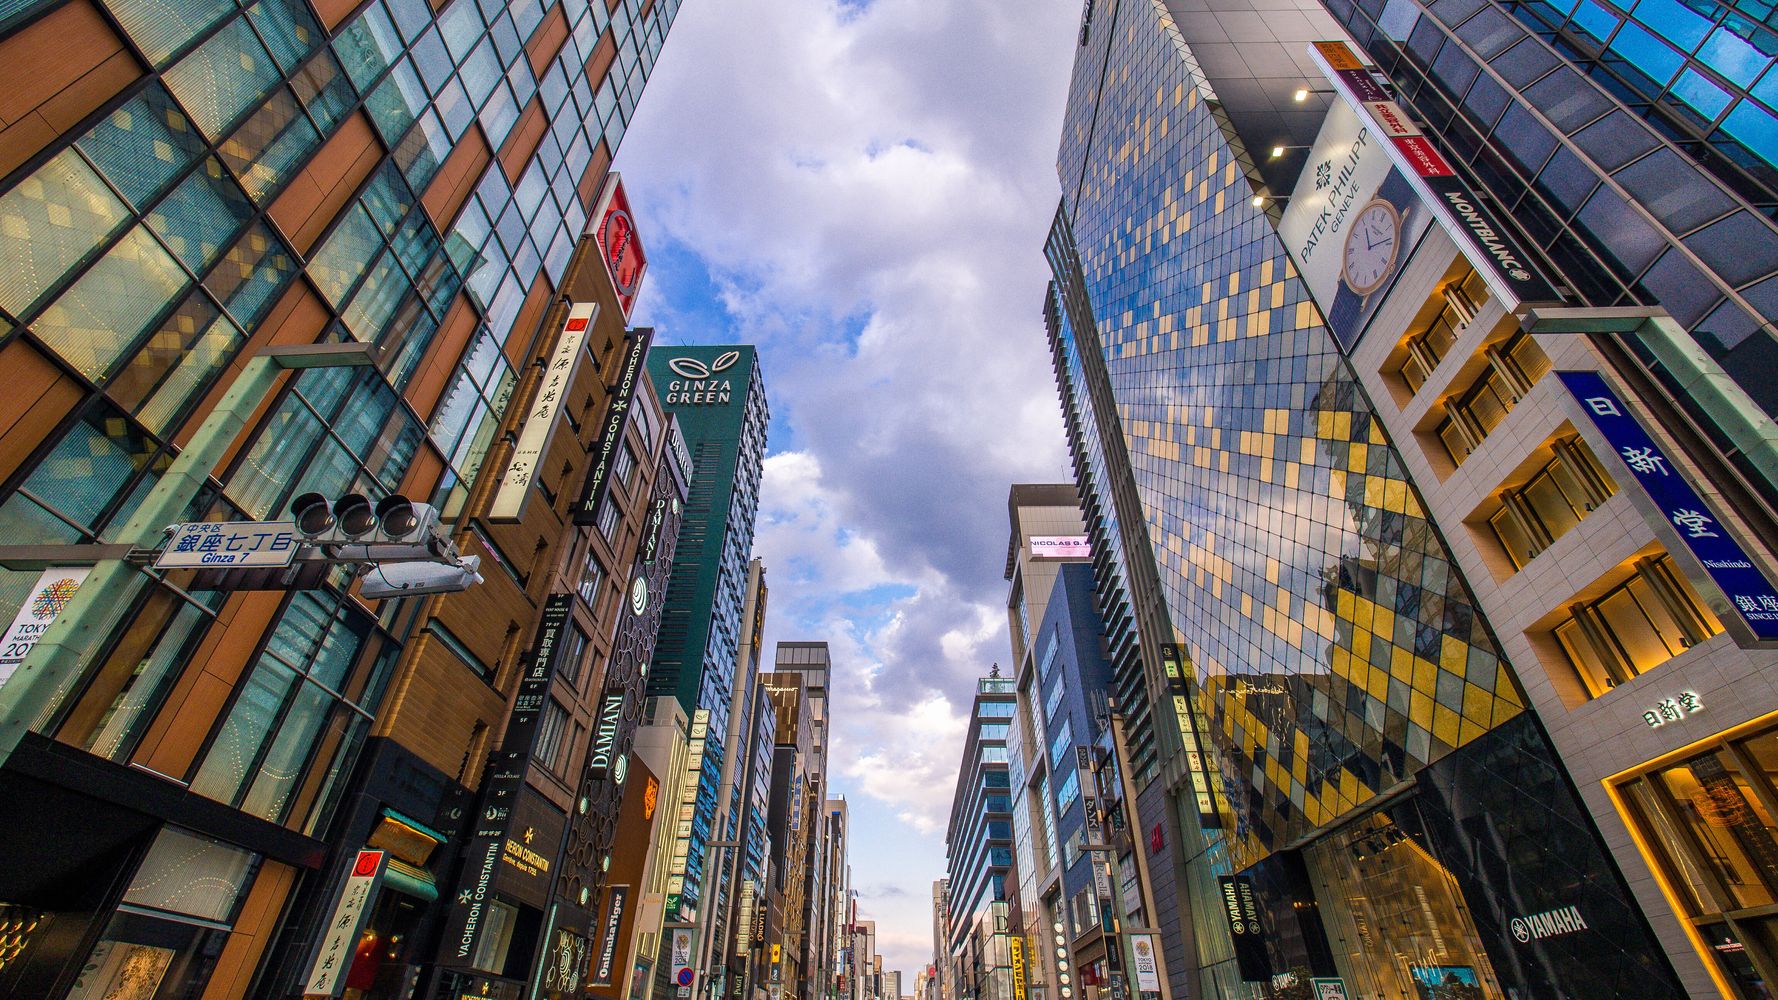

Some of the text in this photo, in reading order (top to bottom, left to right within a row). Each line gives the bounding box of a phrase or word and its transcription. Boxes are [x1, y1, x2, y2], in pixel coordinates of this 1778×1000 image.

[1405, 138, 1440, 175] 東京外科
[1300, 207, 1332, 264] PATEK
[1327, 127, 1368, 208] PHILIPP
[1444, 192, 1522, 269] MONTBLANC
[666, 392, 731, 404] GREEN
[669, 380, 731, 391] GINZA
[584, 335, 645, 510] VACHERON CONSTANTIN
[1585, 397, 1719, 538] 日新堂
[173, 532, 293, 552] 銀座七丁目
[186, 523, 224, 533] 中央区
[646, 499, 665, 560] DAMIANI
[201, 552, 250, 563] Ginza 7
[1702, 560, 1751, 568] Nisshindo
[1734, 594, 1778, 611] 銀座
[1746, 612, 1773, 620] SINCE
[18, 624, 50, 634] TOKY
[2, 642, 35, 657] 201
[532, 629, 556, 677] 買取専門店
[1642, 692, 1700, 727] 日新堂
[591, 695, 623, 769] DAMIANI
[1086, 800, 1098, 828] ダンス
[522, 845, 550, 872] CONSTANTIN
[457, 842, 499, 957] VACHERON CONSTANTIN
[1223, 882, 1242, 922] YAMAHA
[600, 893, 622, 978] OnitsukaTiger
[1523, 905, 1588, 940] YAMAHA
